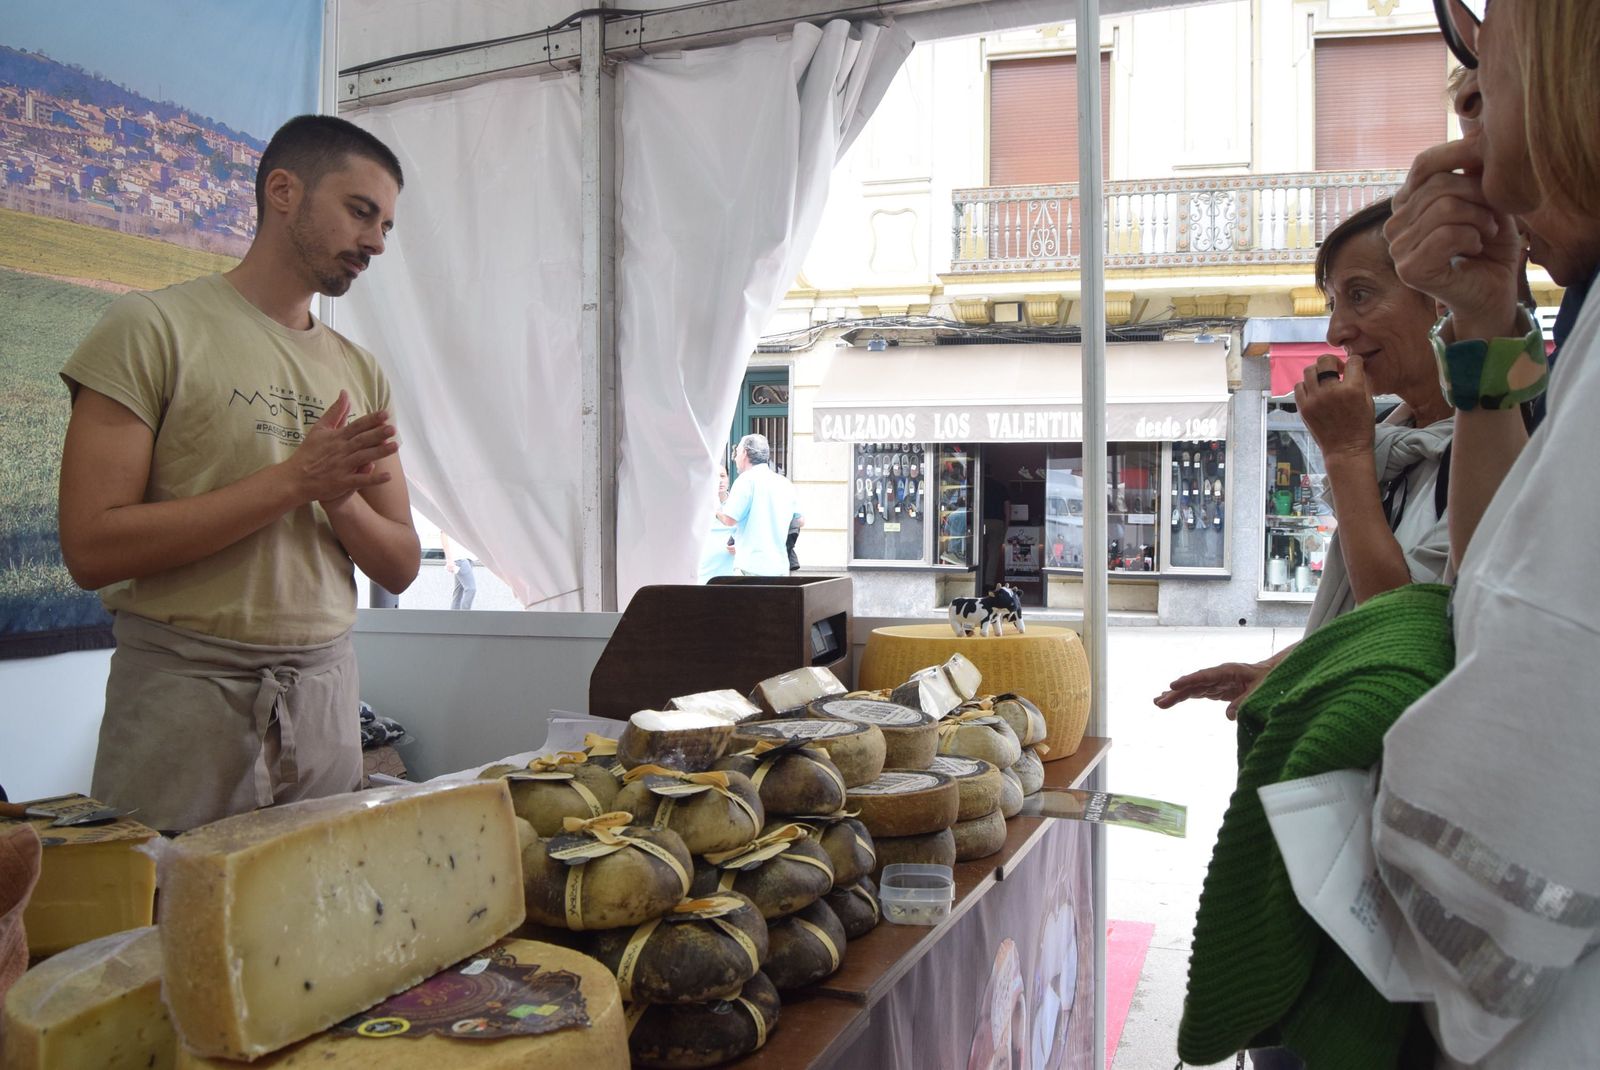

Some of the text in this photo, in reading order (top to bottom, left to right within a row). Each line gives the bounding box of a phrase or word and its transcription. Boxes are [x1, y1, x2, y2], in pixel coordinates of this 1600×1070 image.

[821, 413, 916, 439] CALZADOS
[934, 413, 970, 439] LOS
[986, 411, 1109, 438] VALENTIN
[1136, 416, 1181, 438] desde
